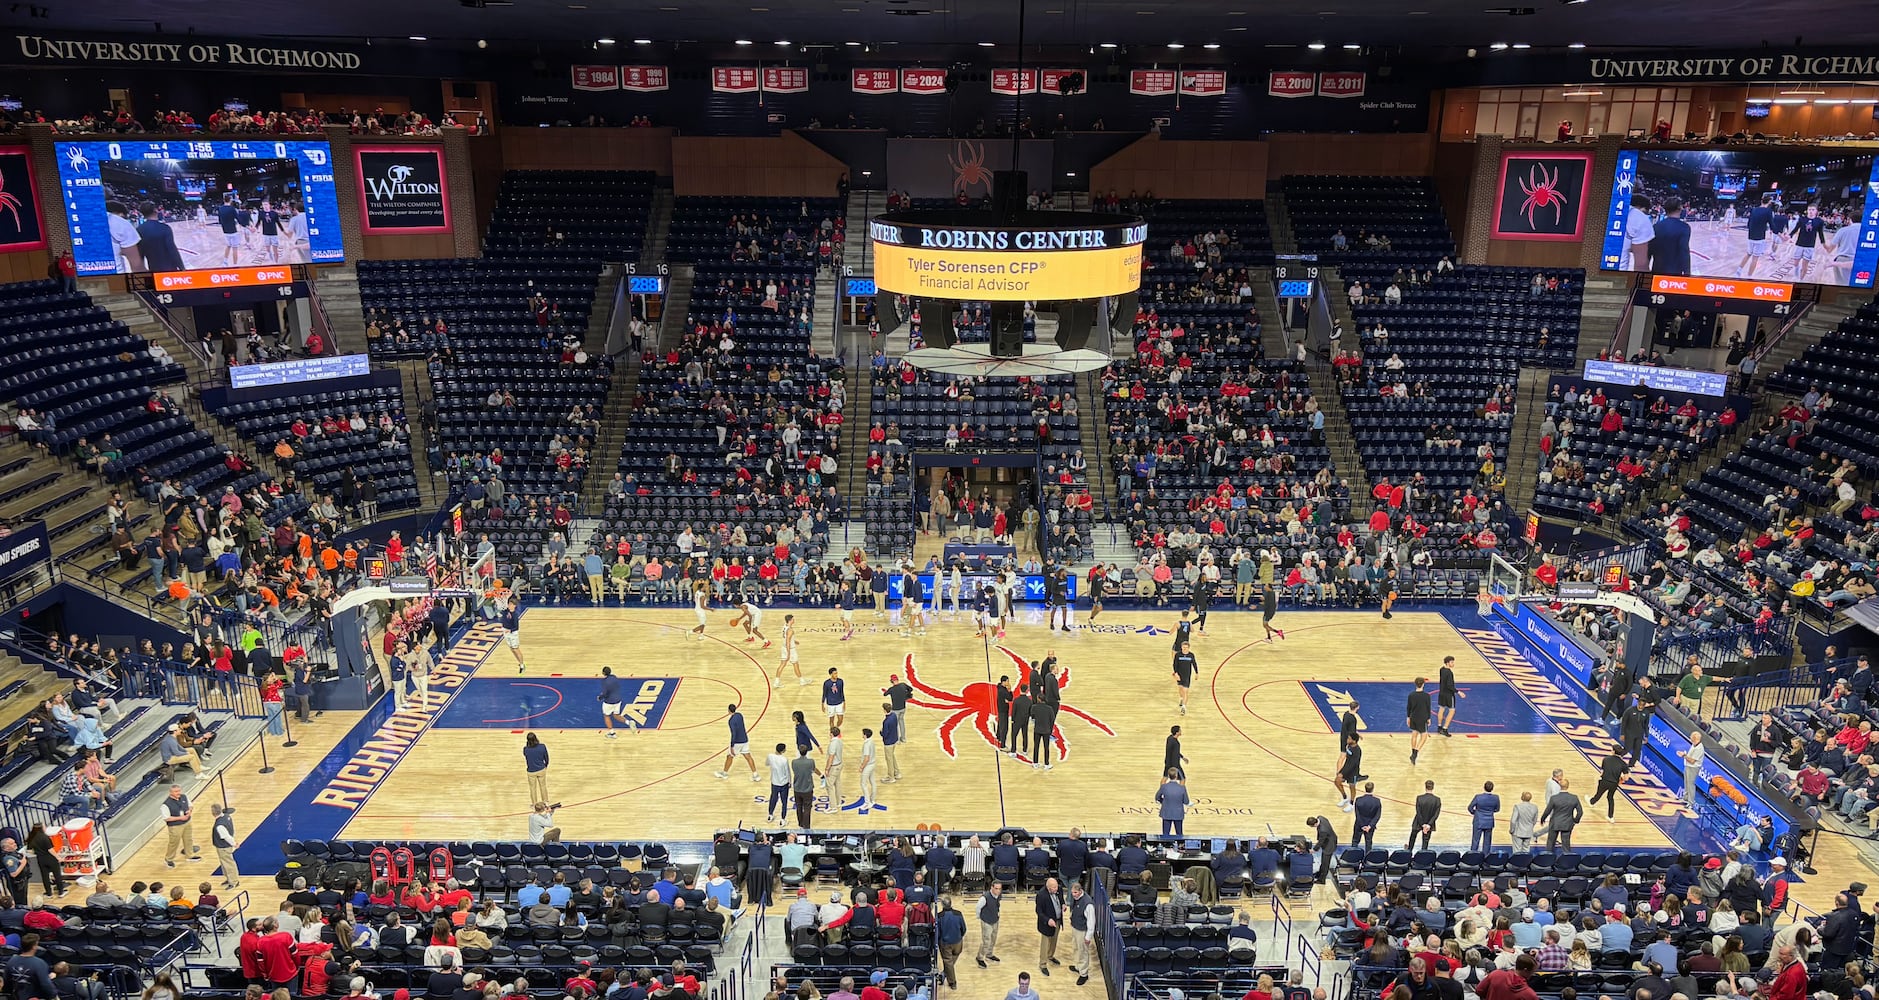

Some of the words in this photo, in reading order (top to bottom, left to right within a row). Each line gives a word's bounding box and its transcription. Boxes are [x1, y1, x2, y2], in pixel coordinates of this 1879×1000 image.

[16, 36, 182, 62] UNIVERSITY
[189, 45, 220, 63] OF
[226, 43, 361, 69] RICHMOND
[1590, 58, 1735, 77] UNIVERSITY
[1740, 58, 1773, 76] OF
[591, 72, 614, 82] 1984
[647, 78, 663, 86] 1991
[920, 76, 944, 86] 2024
[1288, 78, 1312, 89] 2010
[1338, 78, 1361, 89] 2011
[1360, 102, 1379, 110] Spider
[109, 144, 122, 159] 0
[188, 143, 212, 152] 1:56
[275, 143, 286, 158] 0
[1623, 159, 1631, 169] 0
[366, 178, 438, 200] WILTON
[1616, 201, 1624, 210] 4
[1870, 209, 1879, 219] 4
[1614, 221, 1620, 229] 0
[921, 229, 1008, 249] ROBINS
[1015, 228, 1107, 249] CENTER
[1867, 231, 1875, 241] 0
[625, 263, 636, 274] 15
[657, 264, 668, 275] 16
[842, 266, 854, 276] 16
[908, 258, 935, 272] Tyler
[938, 260, 1005, 274] Sorensen
[1276, 267, 1286, 278] 18
[1307, 267, 1318, 278] 19
[221, 274, 240, 282] PNC
[920, 275, 974, 290] Financial
[978, 278, 1029, 291] Advisor
[1669, 281, 1688, 290] PNC
[1716, 284, 1735, 294] PNC
[278, 286, 292, 296] 15
[1764, 288, 1784, 297] PNC
[157, 294, 173, 304] 13
[1651, 294, 1666, 304] 19
[1774, 304, 1790, 314] 21
[371, 567, 382, 576] 30
[1606, 574, 1618, 582] 30
[1457, 627, 1591, 720] RICHMOND
[1696, 910, 1706, 922] 21
